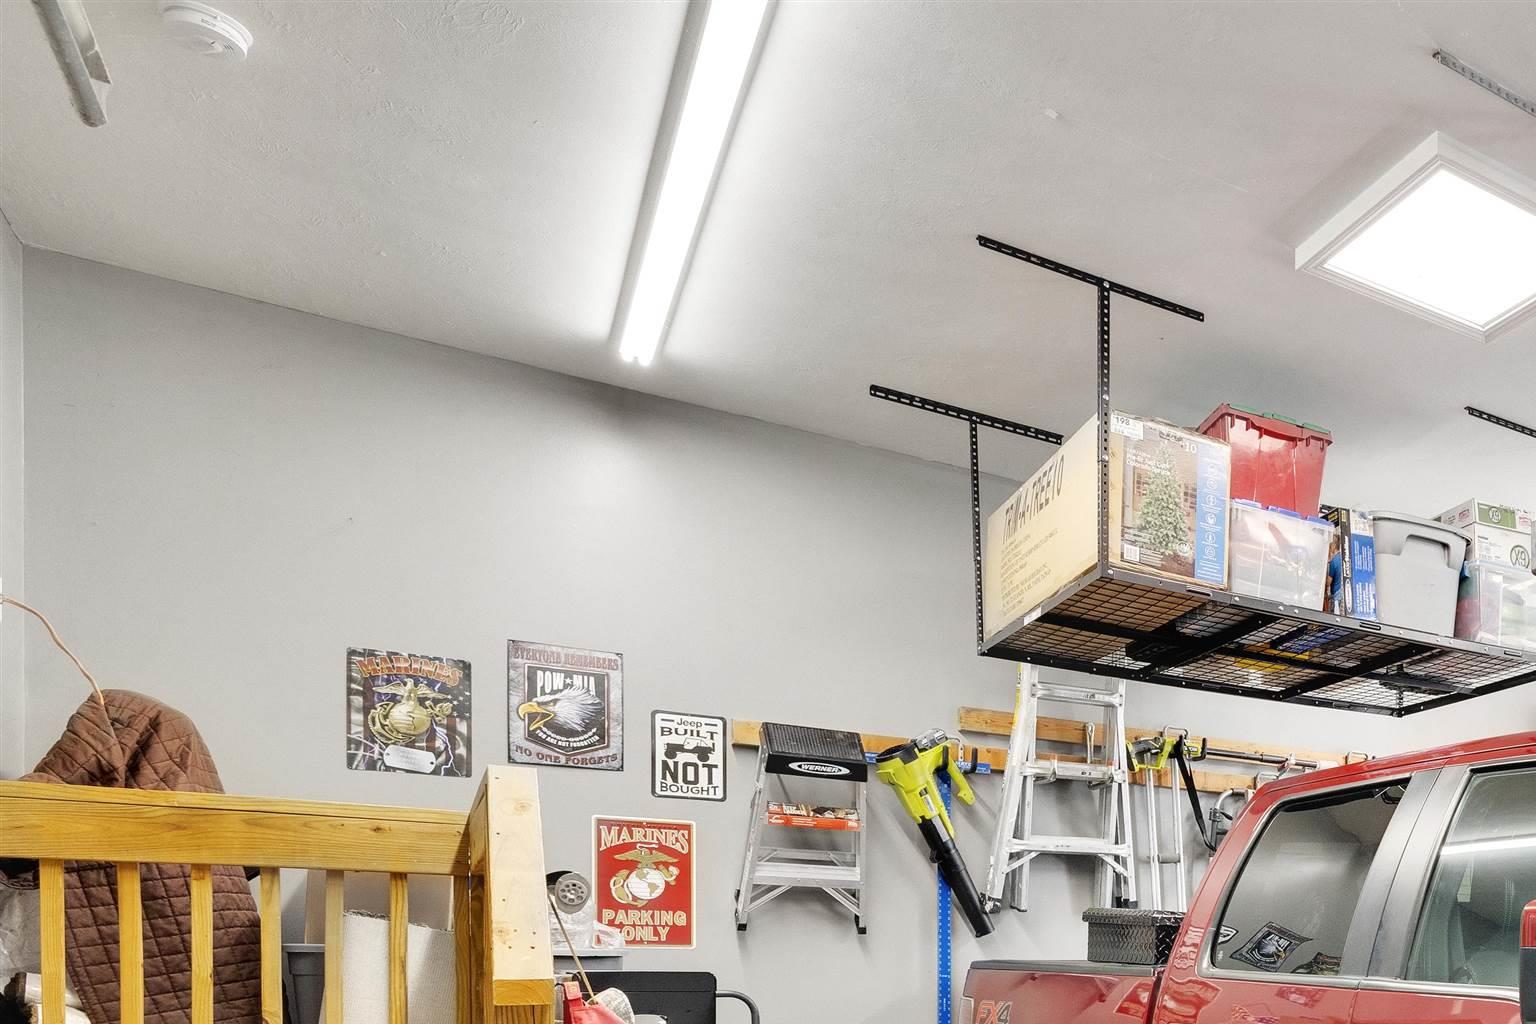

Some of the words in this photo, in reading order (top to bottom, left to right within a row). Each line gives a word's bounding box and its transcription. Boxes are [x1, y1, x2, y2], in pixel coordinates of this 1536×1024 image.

[512, 644, 561, 664] EVERYONE
[564, 653, 619, 671] REMEMBERS
[356, 656, 463, 687] MARINES
[536, 670, 565, 697] POW
[573, 674, 596, 696] MIA
[676, 718, 703, 728] Jeep
[660, 726, 719, 741] BUILT
[515, 744, 532, 757] NO
[535, 752, 560, 763] ONE
[564, 753, 618, 766] FORGETS
[661, 759, 718, 785] NOT
[801, 764, 839, 773] WERNER
[660, 781, 719, 796] BOUGHT
[600, 825, 688, 854] MARINES
[602, 908, 687, 926] PARKING
[623, 926, 670, 941] ONLY
